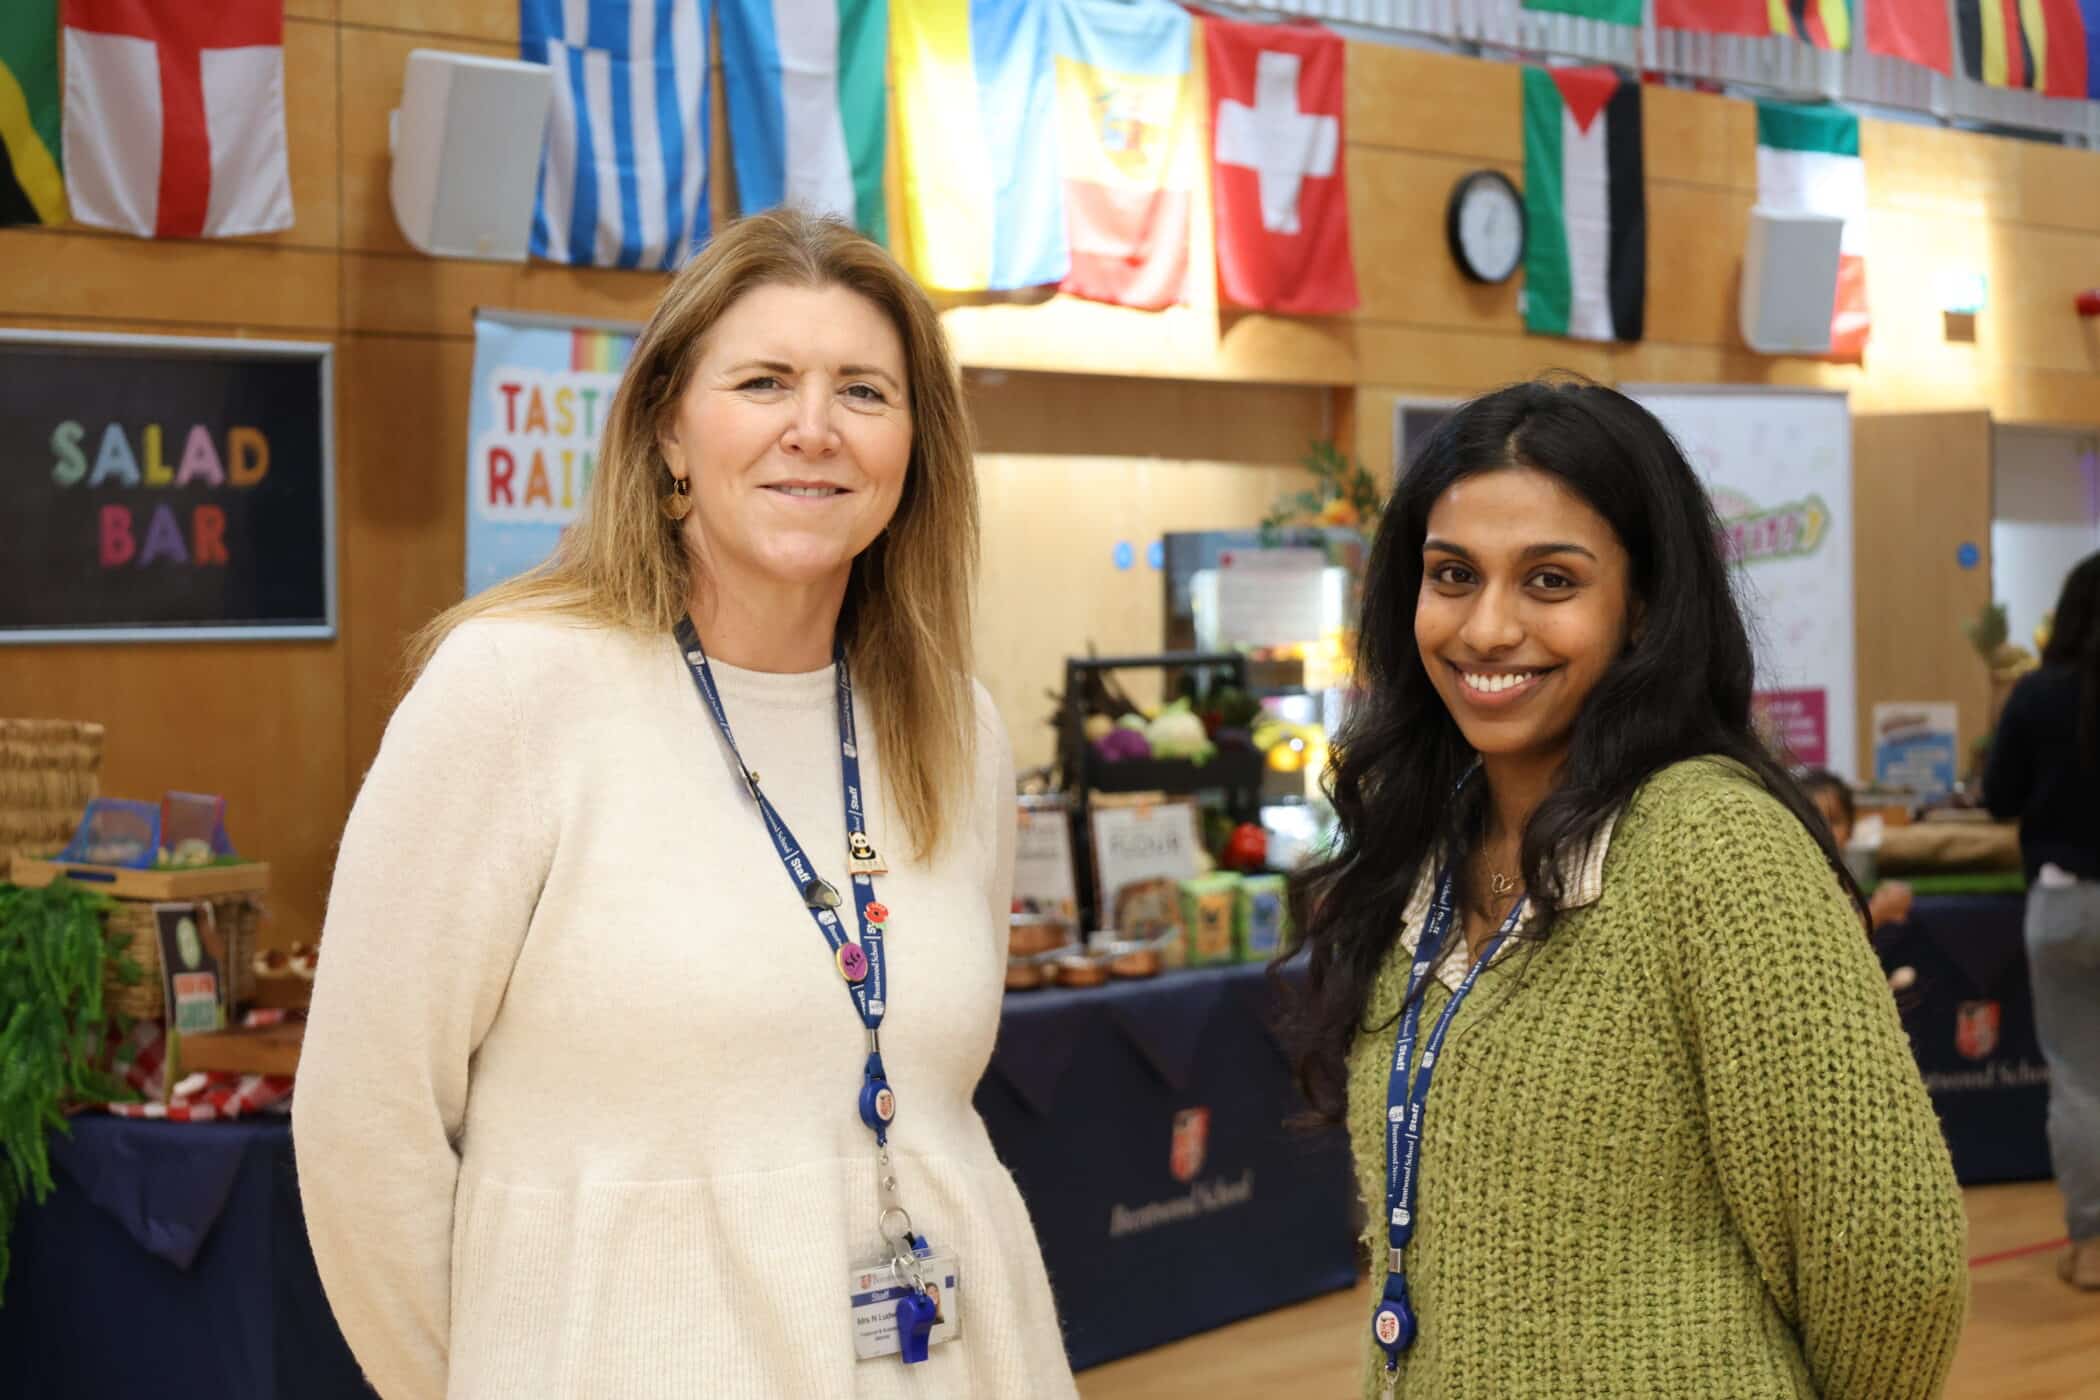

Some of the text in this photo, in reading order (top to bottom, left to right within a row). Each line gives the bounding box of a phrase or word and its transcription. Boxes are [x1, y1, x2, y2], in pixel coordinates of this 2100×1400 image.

[498, 381, 615, 438] TAST
[51, 420, 270, 488] SALAD
[101, 504, 229, 567] BAR
[848, 785, 860, 810] Staff
[790, 857, 812, 883] Staff
[1396, 1044, 1408, 1072] Staff
[1399, 1102, 1420, 1209] Brentwood School Staff
